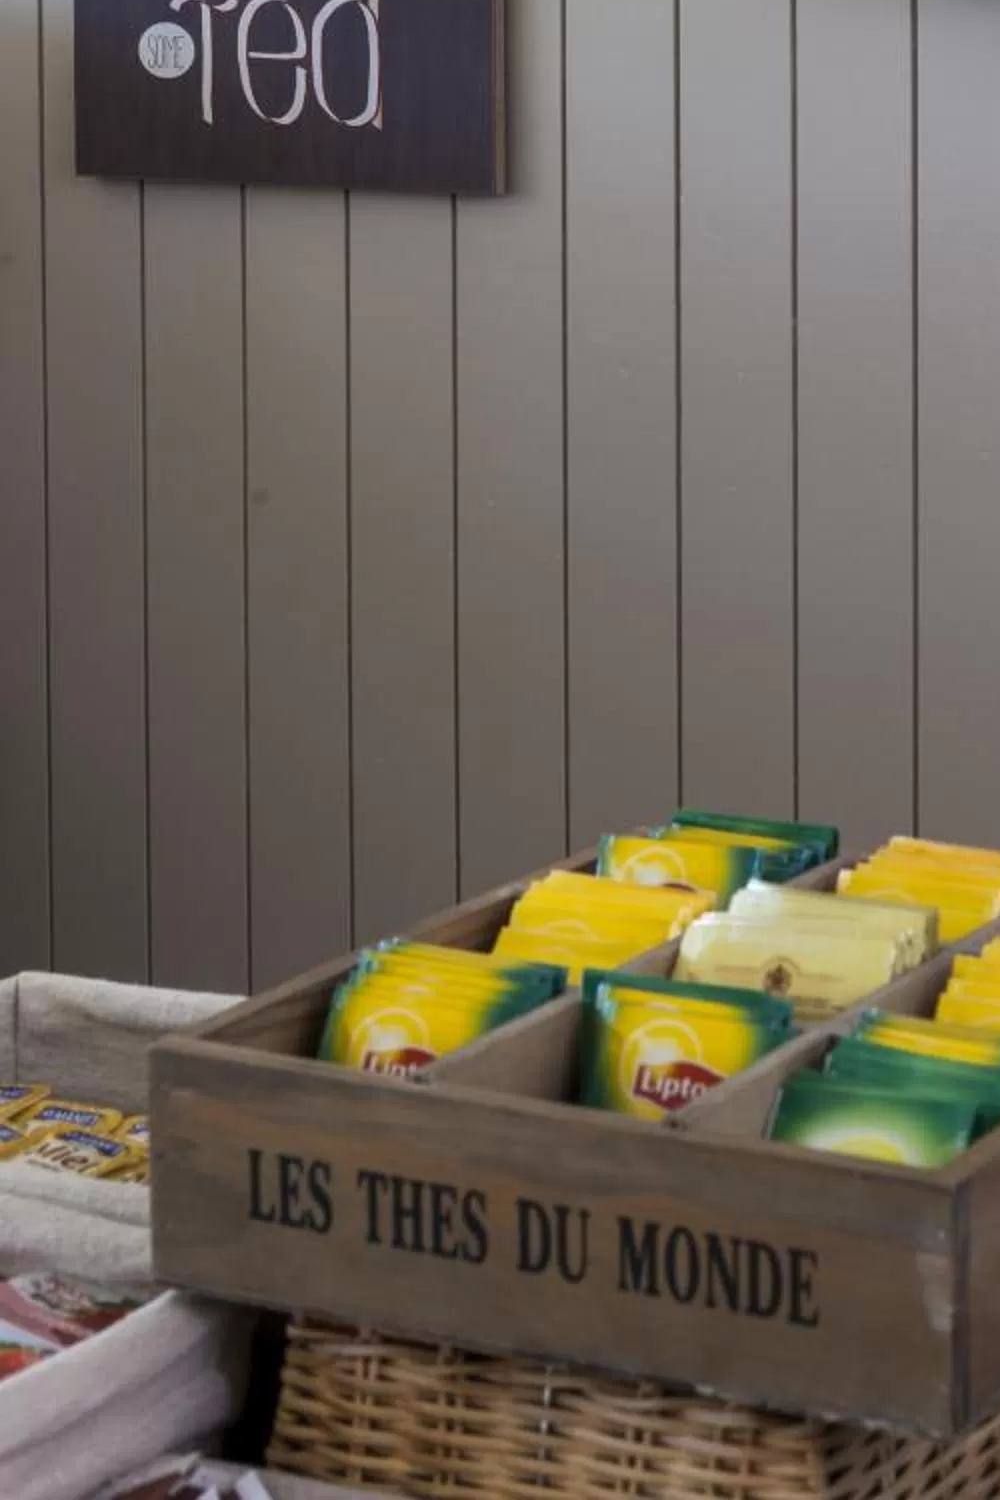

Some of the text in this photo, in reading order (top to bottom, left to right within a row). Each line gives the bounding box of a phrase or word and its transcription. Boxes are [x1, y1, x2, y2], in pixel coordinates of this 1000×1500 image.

[147, 33, 187, 70] SOME
[640, 1066, 706, 1102] Lipto
[246, 1148, 820, 1329] LES THES DU MONDE
